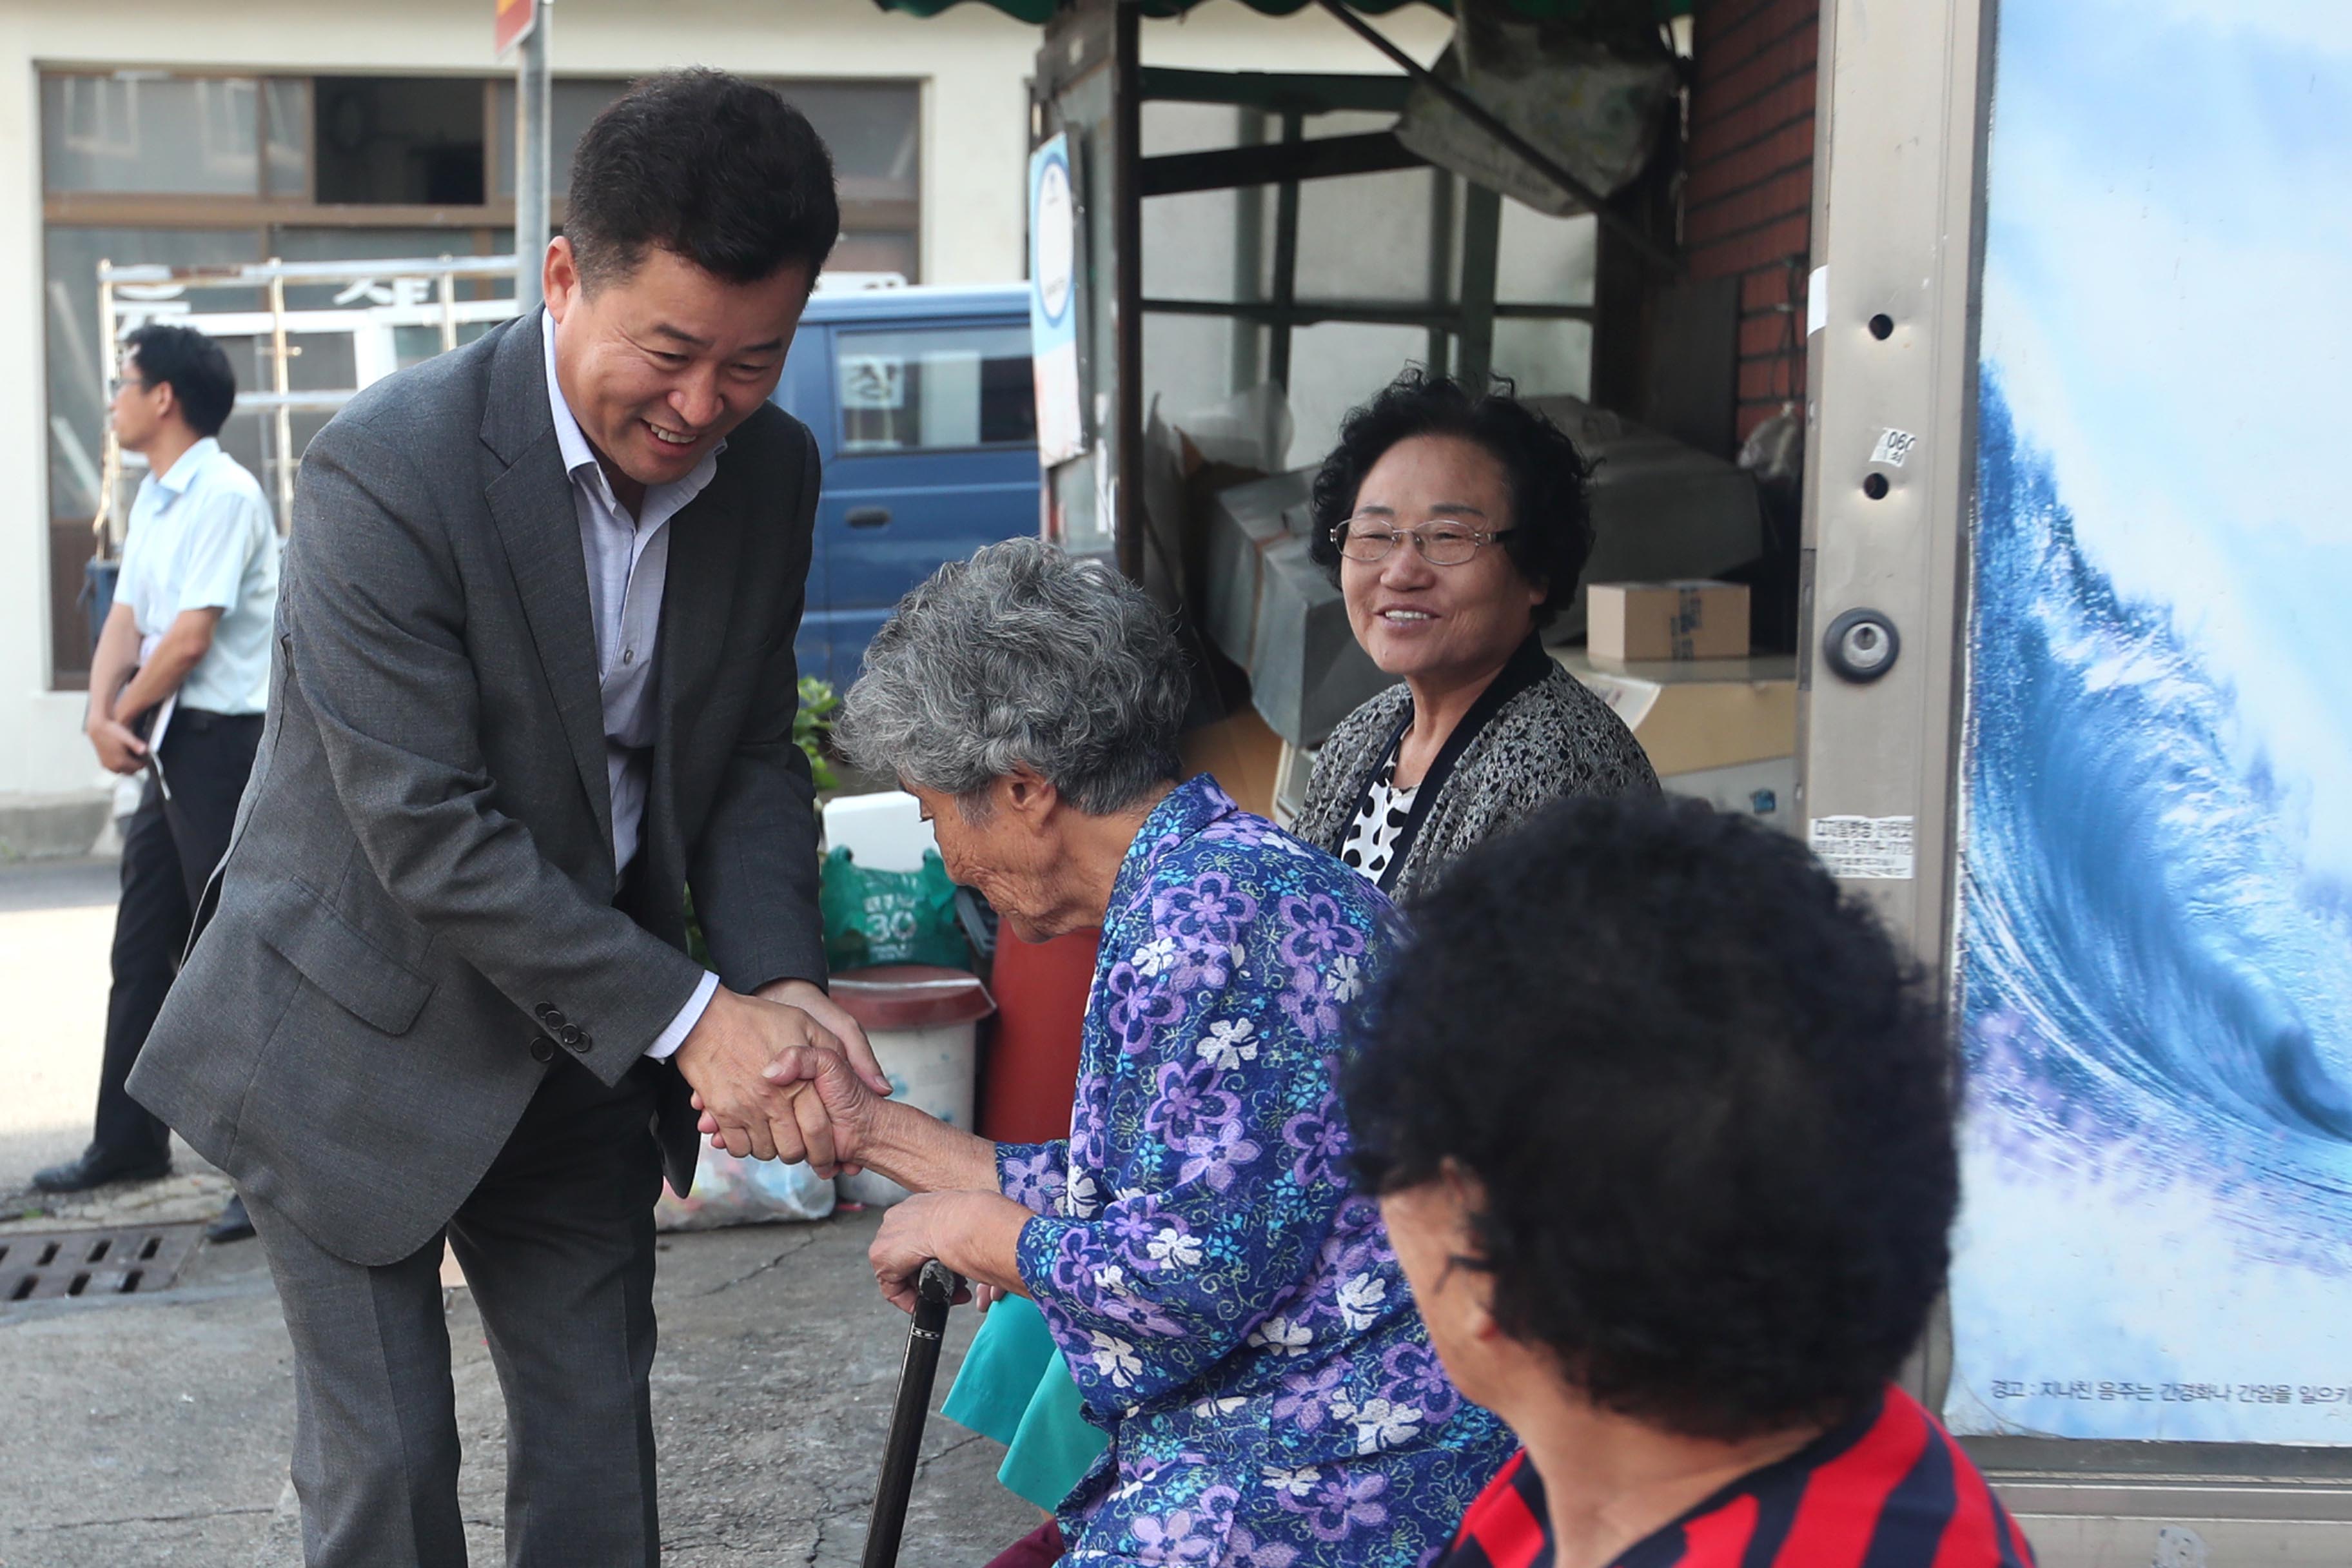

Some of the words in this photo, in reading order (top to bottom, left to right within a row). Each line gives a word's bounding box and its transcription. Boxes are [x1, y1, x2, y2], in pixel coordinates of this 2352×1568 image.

[865, 910, 917, 943] 30
[1992, 1379, 2026, 1400] 경고
[2040, 1380, 2093, 1401] 지나친
[2097, 1381, 2155, 1402] 음주는
[2159, 1382, 2232, 1403] 간경화나
[2237, 1384, 2293, 1404] 간암을
